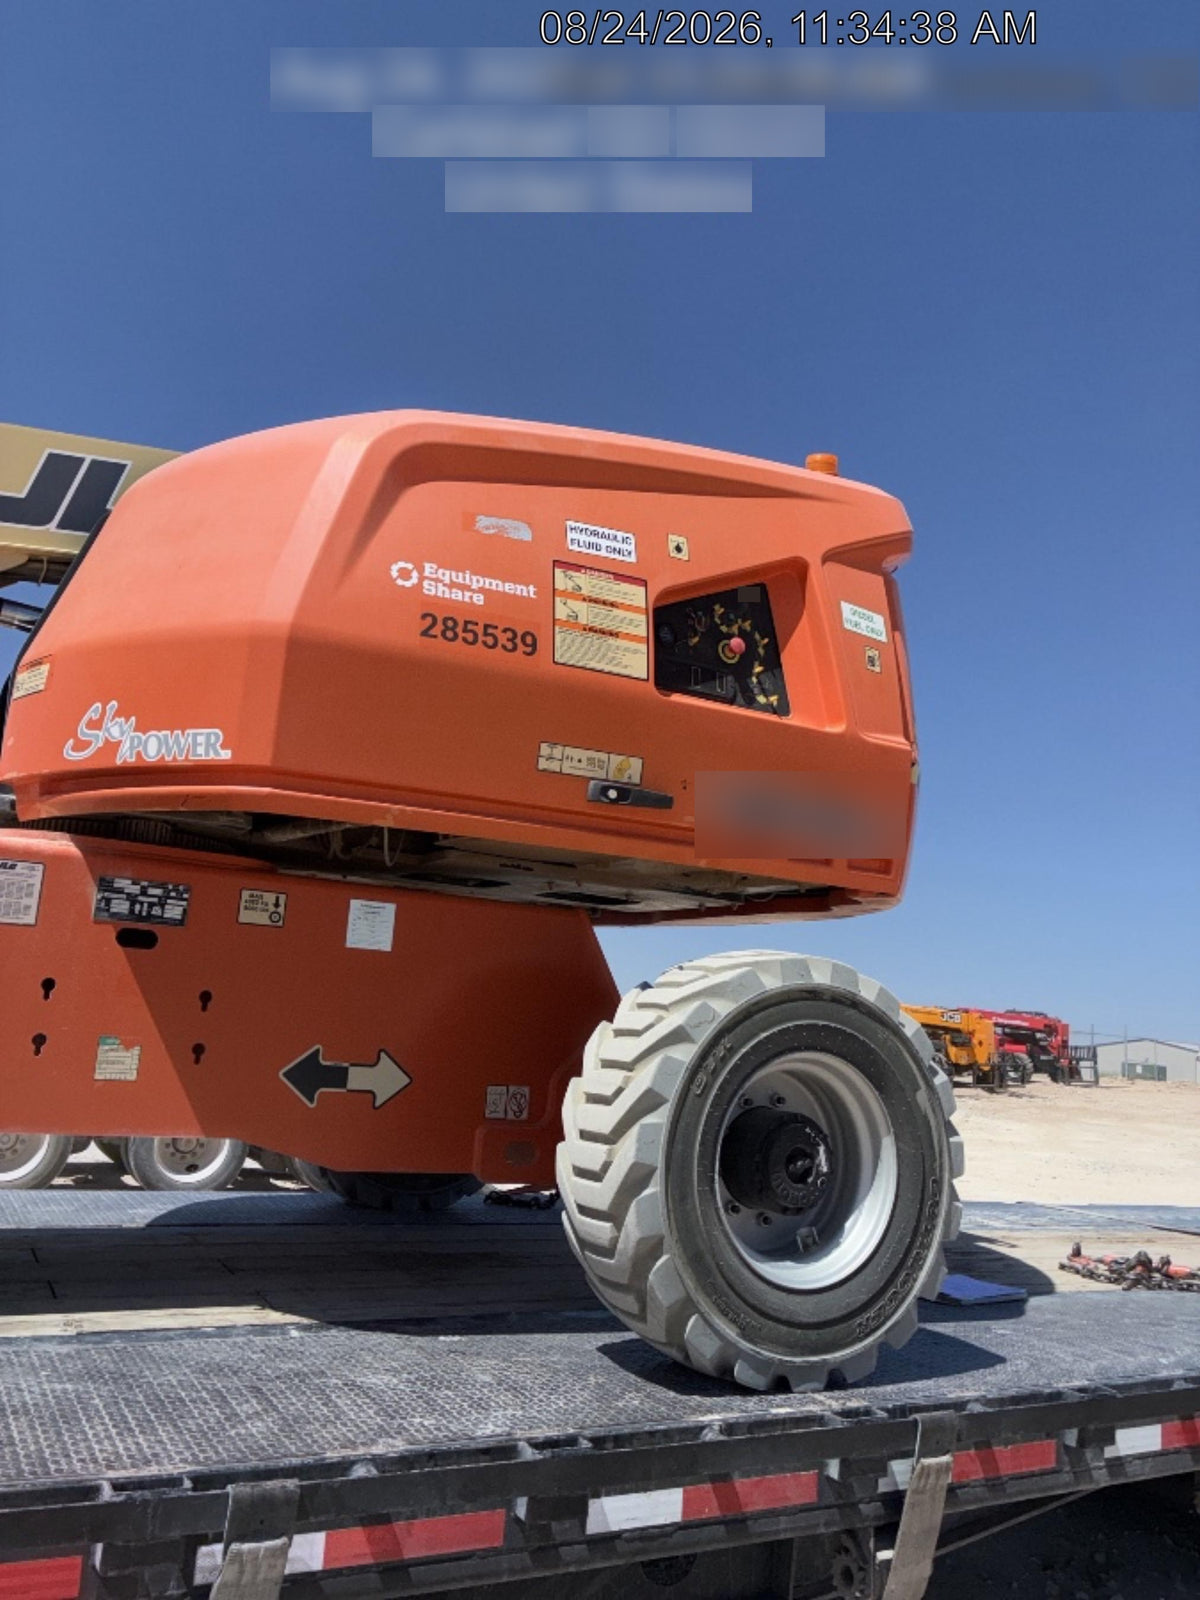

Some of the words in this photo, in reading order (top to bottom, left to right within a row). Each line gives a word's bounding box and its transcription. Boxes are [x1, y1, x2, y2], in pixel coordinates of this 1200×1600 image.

[569, 524, 632, 546] HYDRAULIC
[570, 538, 602, 551] FLUID
[605, 545, 632, 559] ONLY
[422, 579, 484, 605] Share
[423, 562, 538, 598] Equipment
[420, 612, 538, 657] 285539
[63, 700, 136, 765] Sky
[128, 729, 232, 762] POWER
